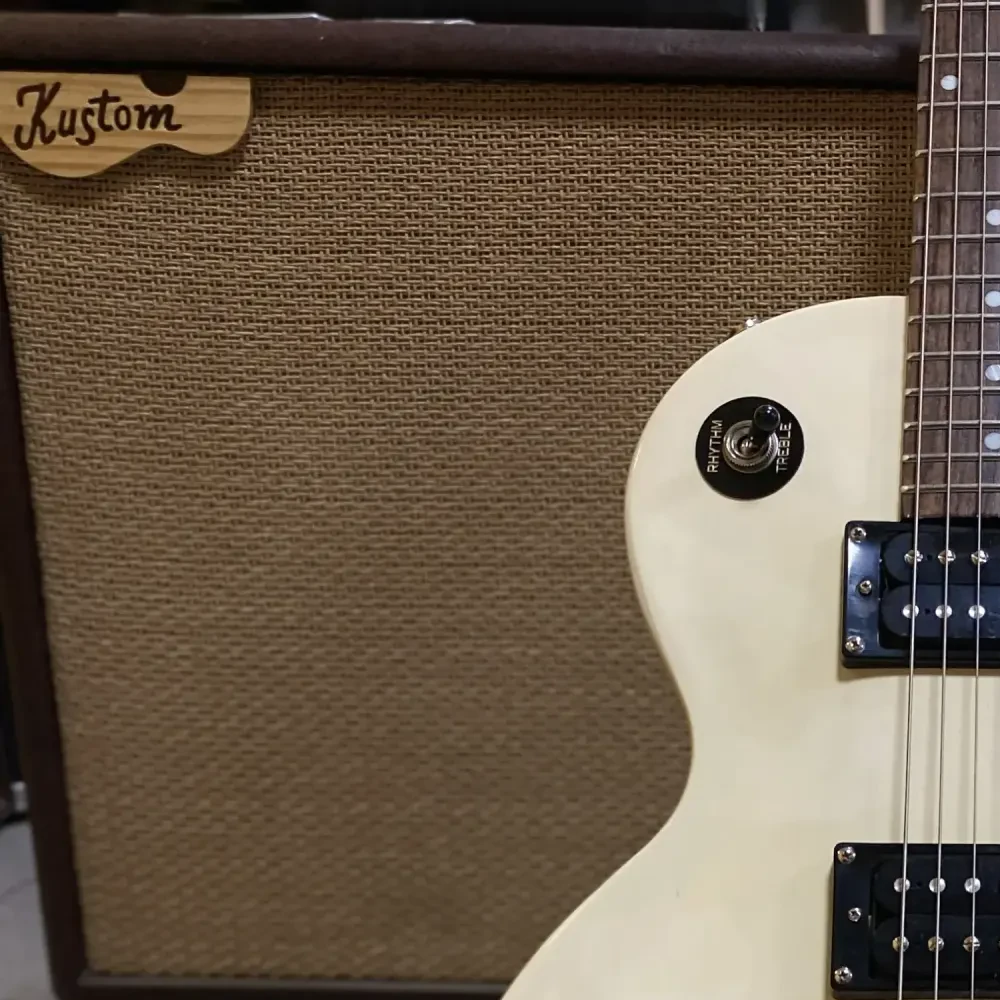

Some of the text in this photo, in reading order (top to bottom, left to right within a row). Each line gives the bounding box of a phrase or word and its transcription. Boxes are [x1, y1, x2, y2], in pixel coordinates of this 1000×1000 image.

[14, 81, 182, 150] Kustom
[707, 420, 723, 473] RHYTHM
[776, 422, 792, 474] TREBLE
